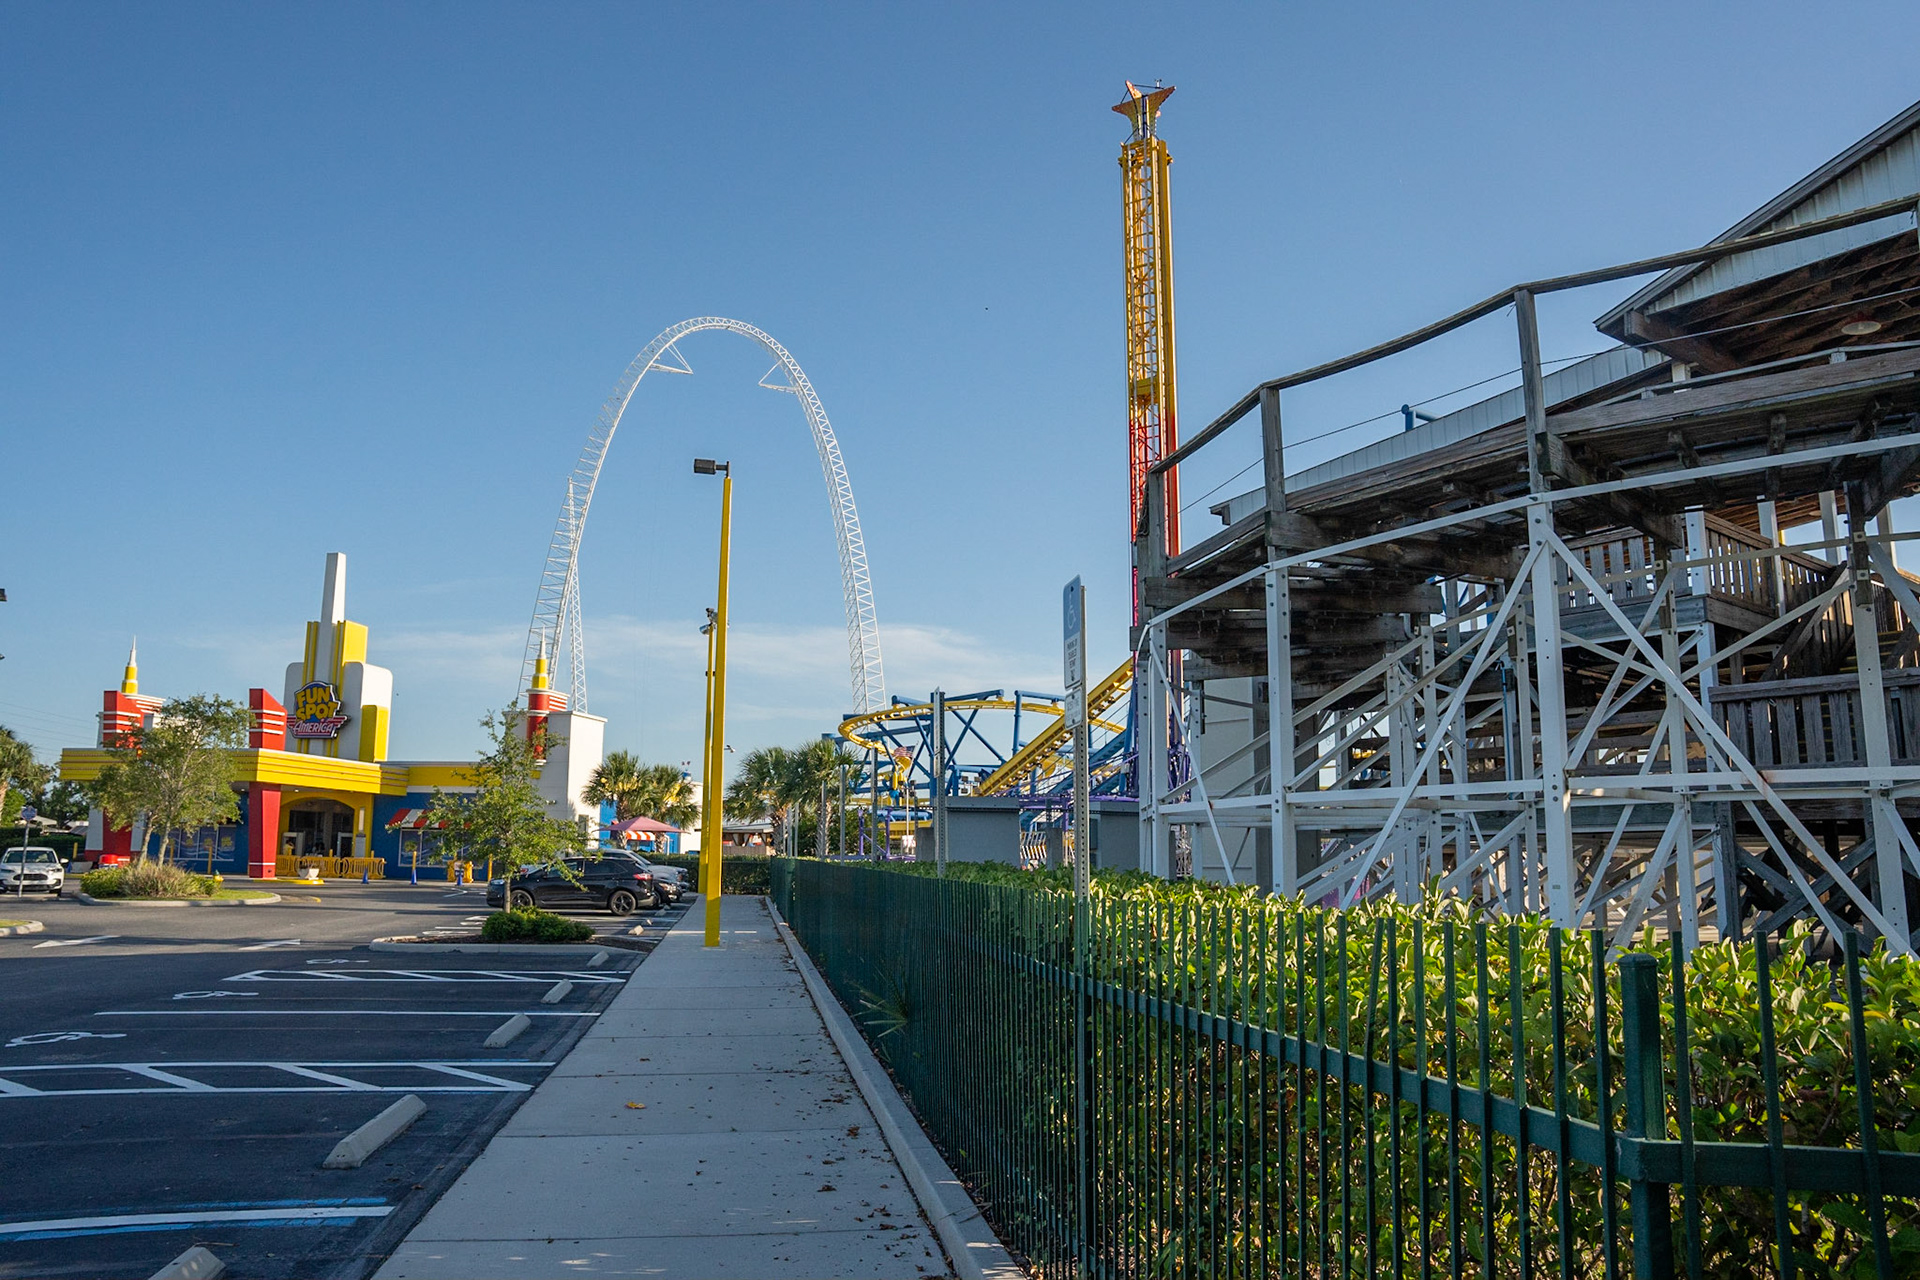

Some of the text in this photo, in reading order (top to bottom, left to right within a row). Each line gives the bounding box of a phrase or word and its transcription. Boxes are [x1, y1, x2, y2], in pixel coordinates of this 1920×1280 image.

[296, 686, 330, 708] FUN
[296, 701, 338, 722] SPOT
[293, 720, 334, 735] AMERICA
